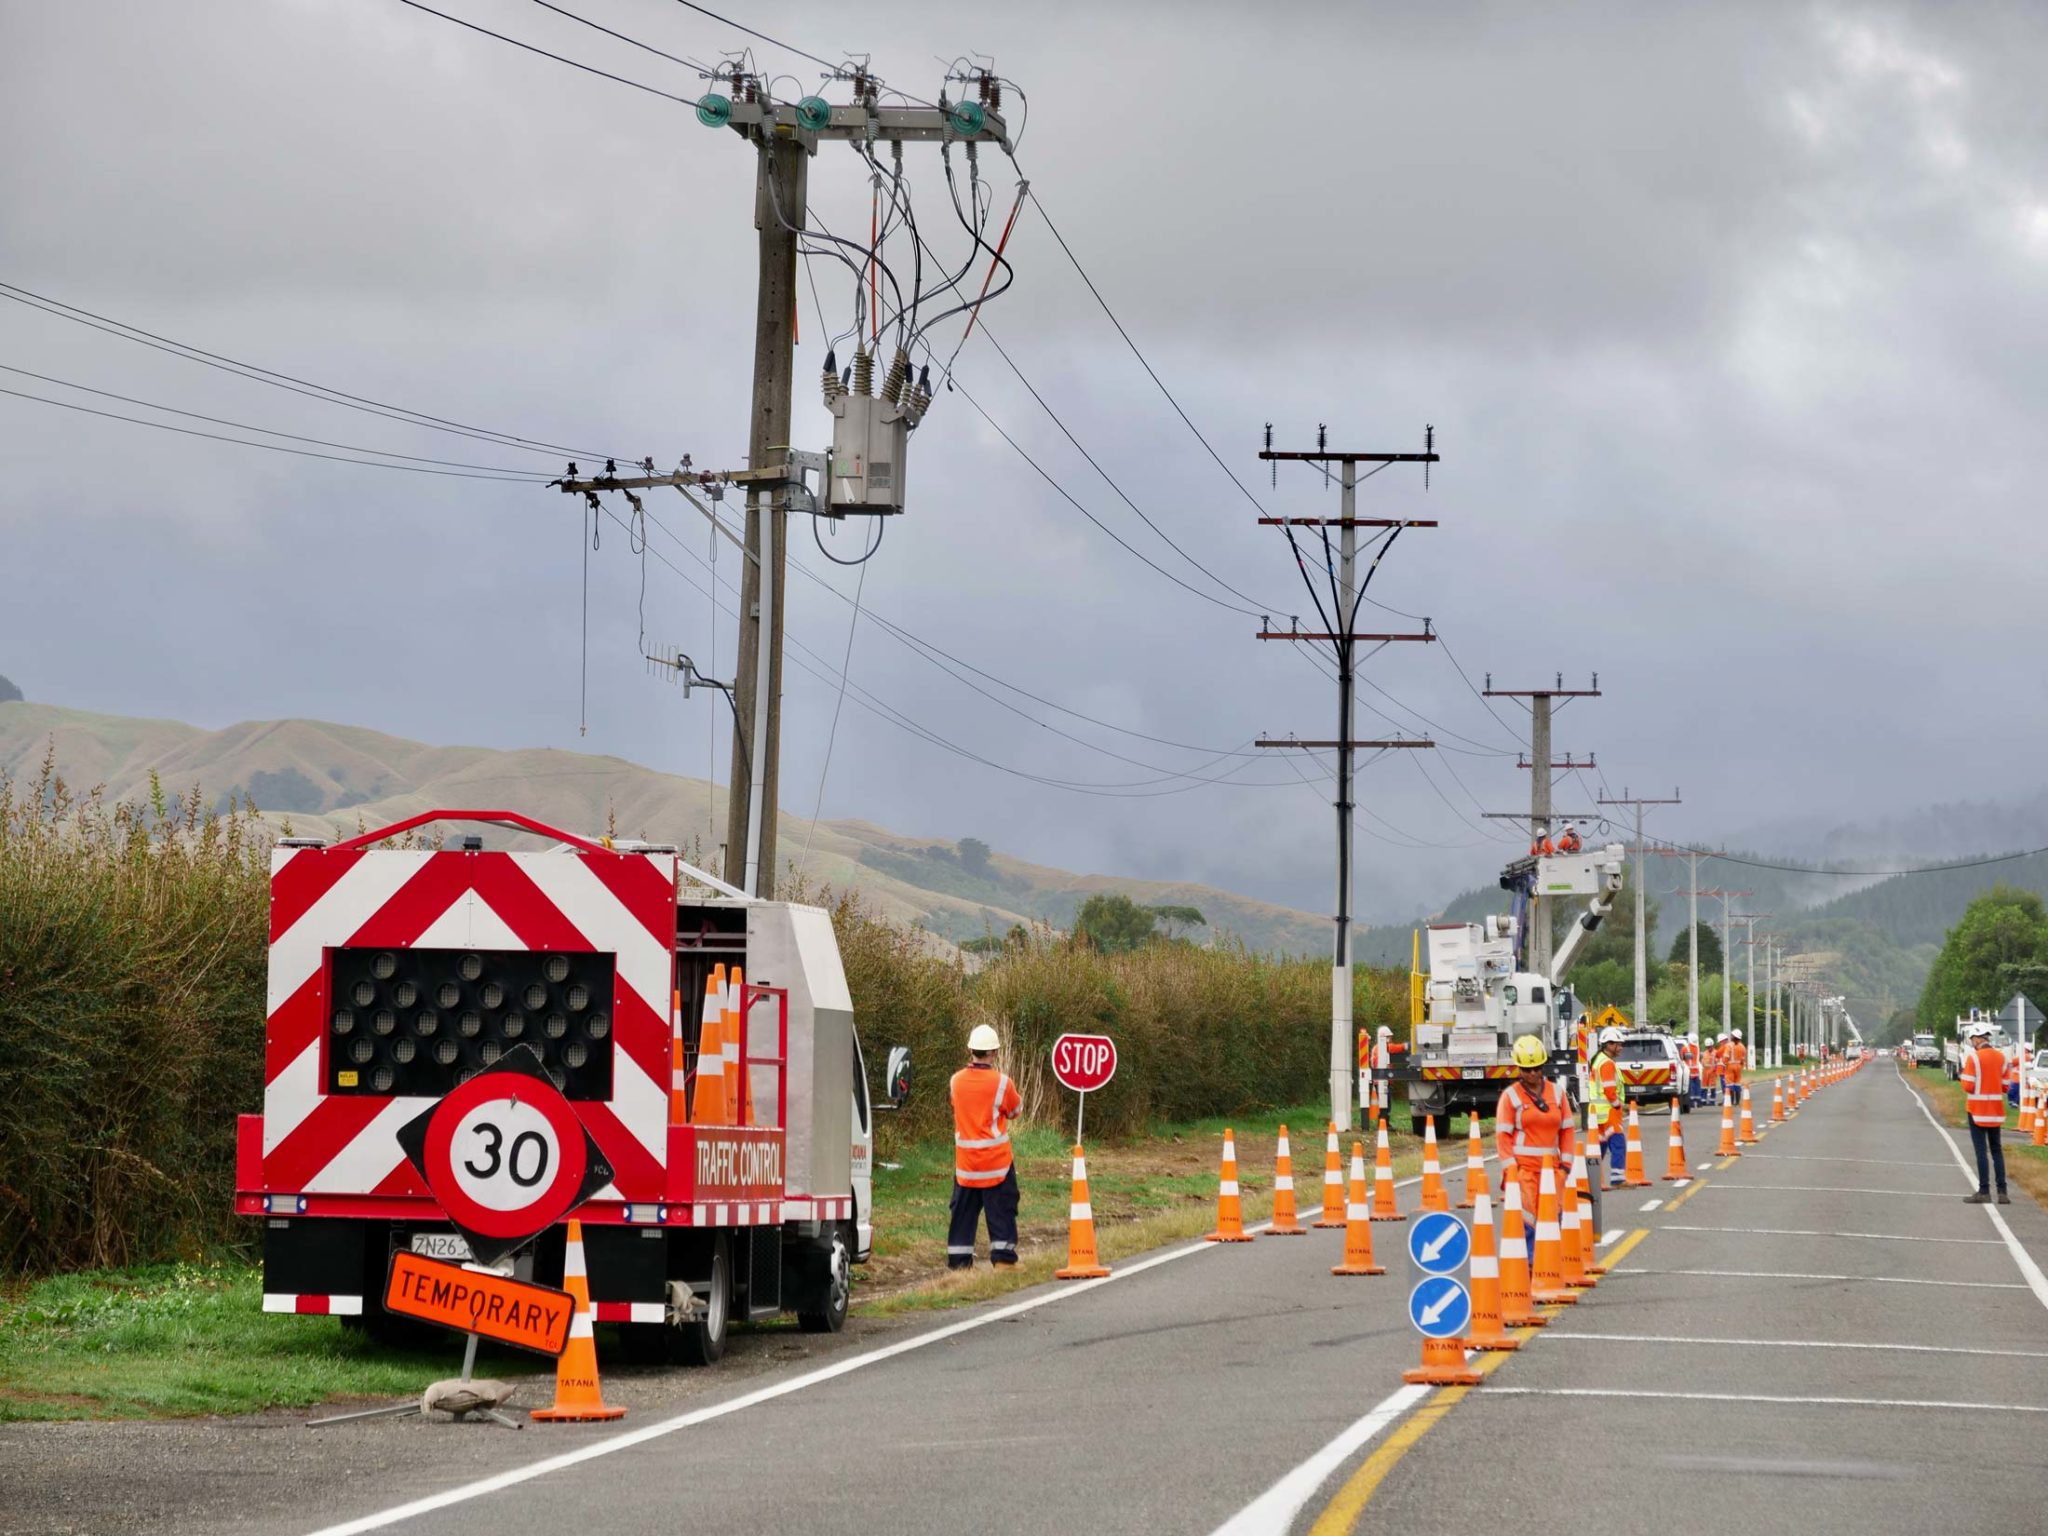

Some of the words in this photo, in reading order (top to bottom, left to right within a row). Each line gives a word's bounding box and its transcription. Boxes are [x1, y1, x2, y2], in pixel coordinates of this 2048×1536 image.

[1059, 1041, 1110, 1076] STOP
[464, 1122, 549, 1188] 30
[697, 1140, 738, 1187] TRAFFIC
[740, 1141, 783, 1187] CONTROL
[402, 1270, 560, 1337] TEMPORARY
[1471, 1311, 1499, 1321] ATANA
[1425, 1342, 1460, 1352] TATANA
[560, 1378, 595, 1388] TATANA
